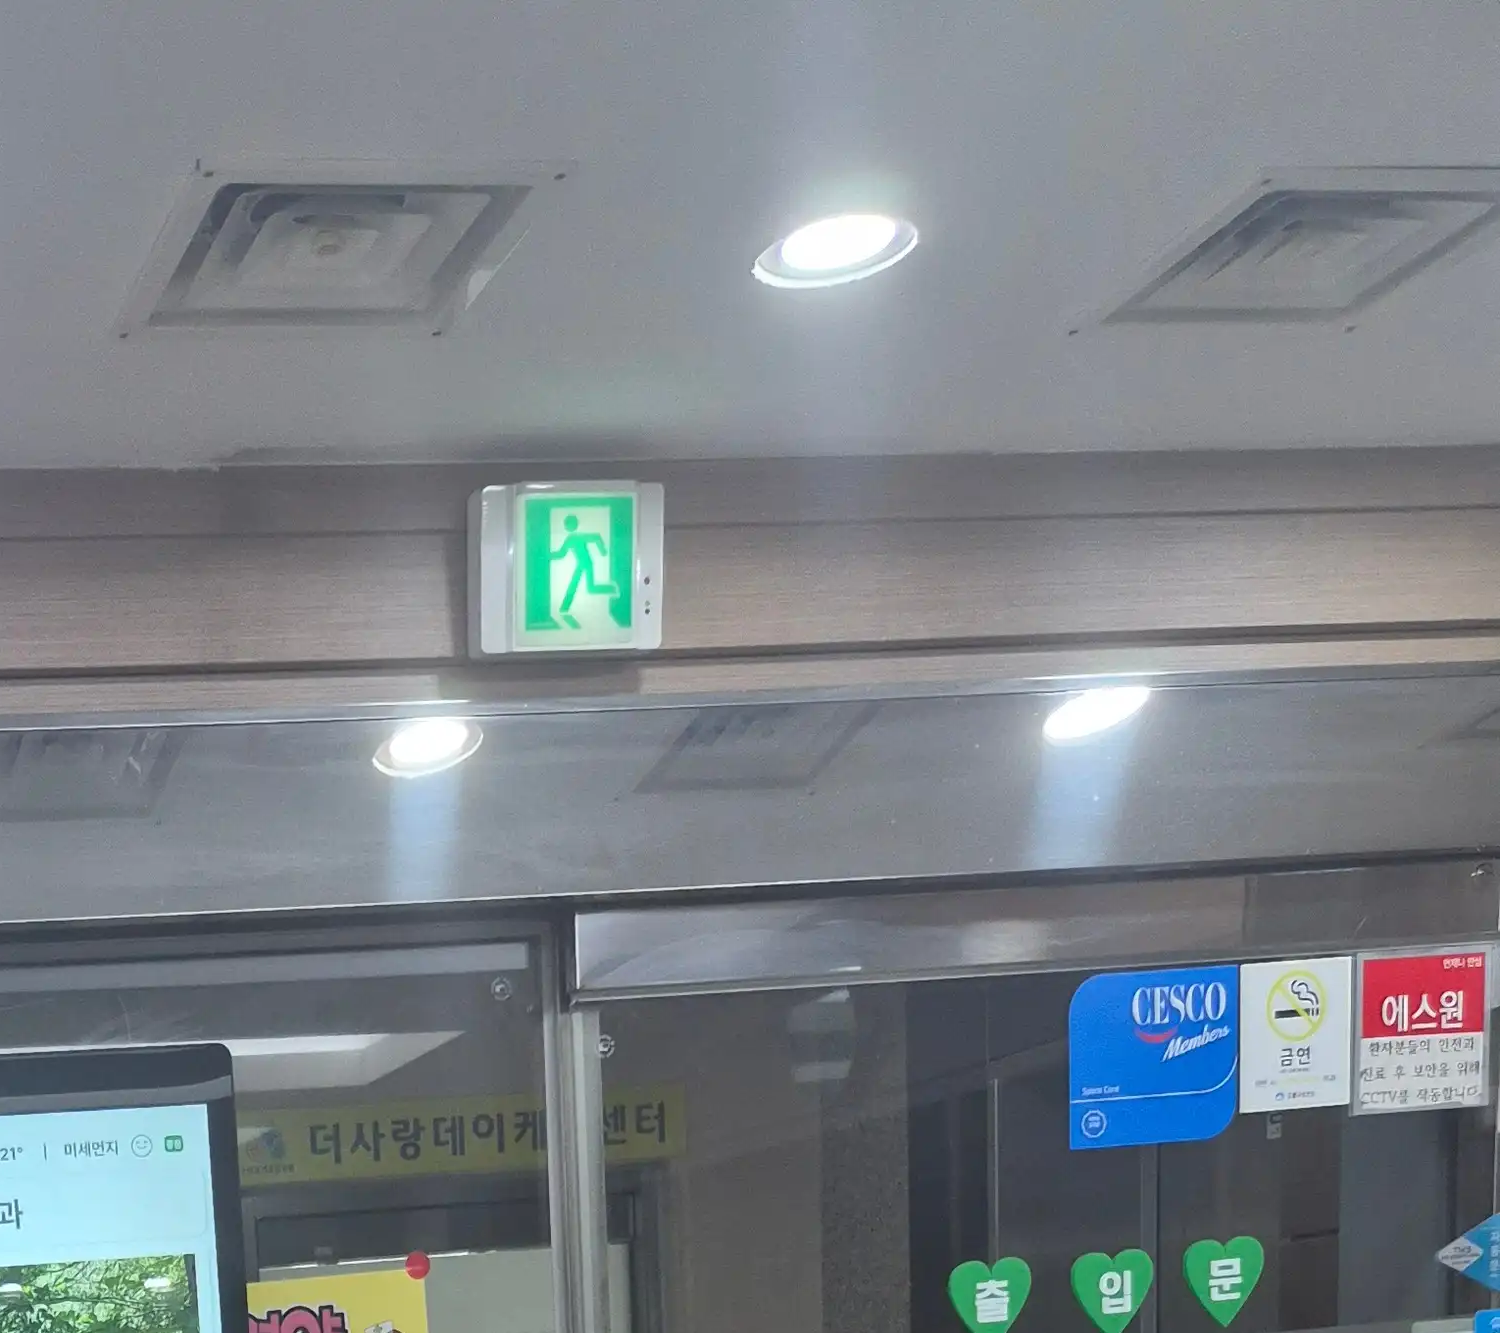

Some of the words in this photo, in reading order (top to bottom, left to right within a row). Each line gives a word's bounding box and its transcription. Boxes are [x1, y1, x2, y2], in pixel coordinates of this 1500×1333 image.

[1132, 981, 1227, 1026] CESCO
[1381, 990, 1464, 1033] 에스원
[1160, 1023, 1230, 1062] Members
[1280, 1045, 1311, 1067] 금연
[1439, 1037, 1475, 1054] 안전과
[1414, 1062, 1450, 1079] 보안을
[64, 1139, 119, 1159] 미세먼지
[309, 1100, 667, 1165] 더사랑데이케센터
[975, 1280, 1009, 1323] 출
[1098, 1270, 1132, 1314] 입
[1207, 1258, 1242, 1302] 문
